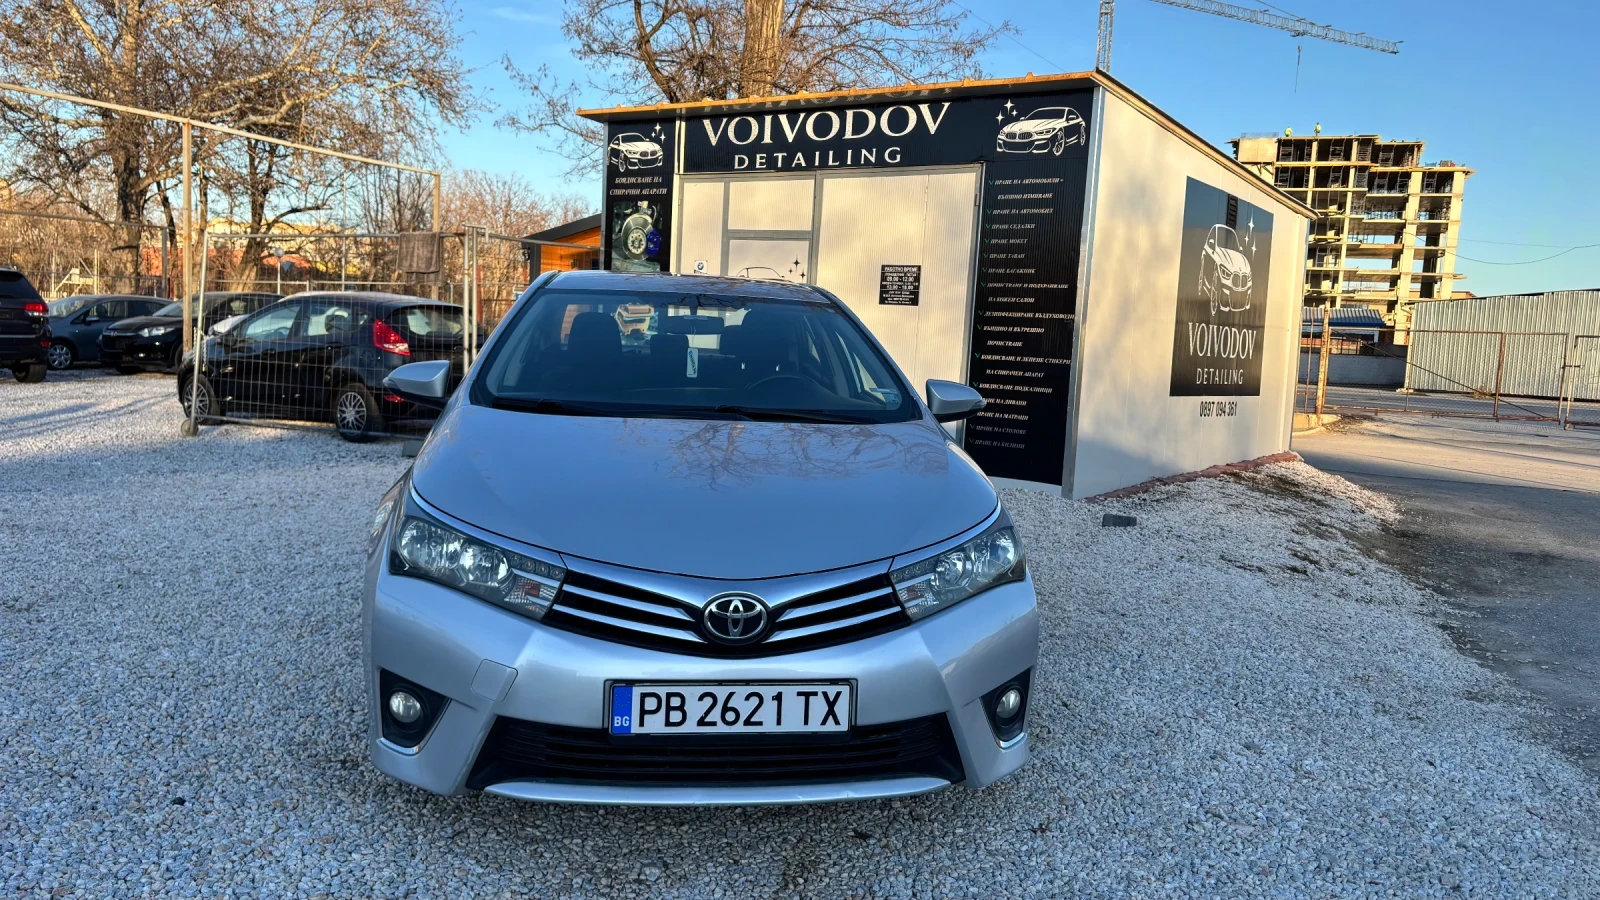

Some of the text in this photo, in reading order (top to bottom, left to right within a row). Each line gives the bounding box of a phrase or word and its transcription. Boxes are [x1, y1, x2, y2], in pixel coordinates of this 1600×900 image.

[702, 102, 952, 146] VOIVODOV
[734, 147, 901, 169] DETAILING
[1188, 322, 1256, 360] VOIVODOV
[1196, 368, 1243, 384] DETAILING
[1200, 401, 1215, 417] 0897
[1216, 401, 1226, 417] 094
[638, 691, 842, 728] PB 2621 TX
[614, 716, 630, 727] BG
